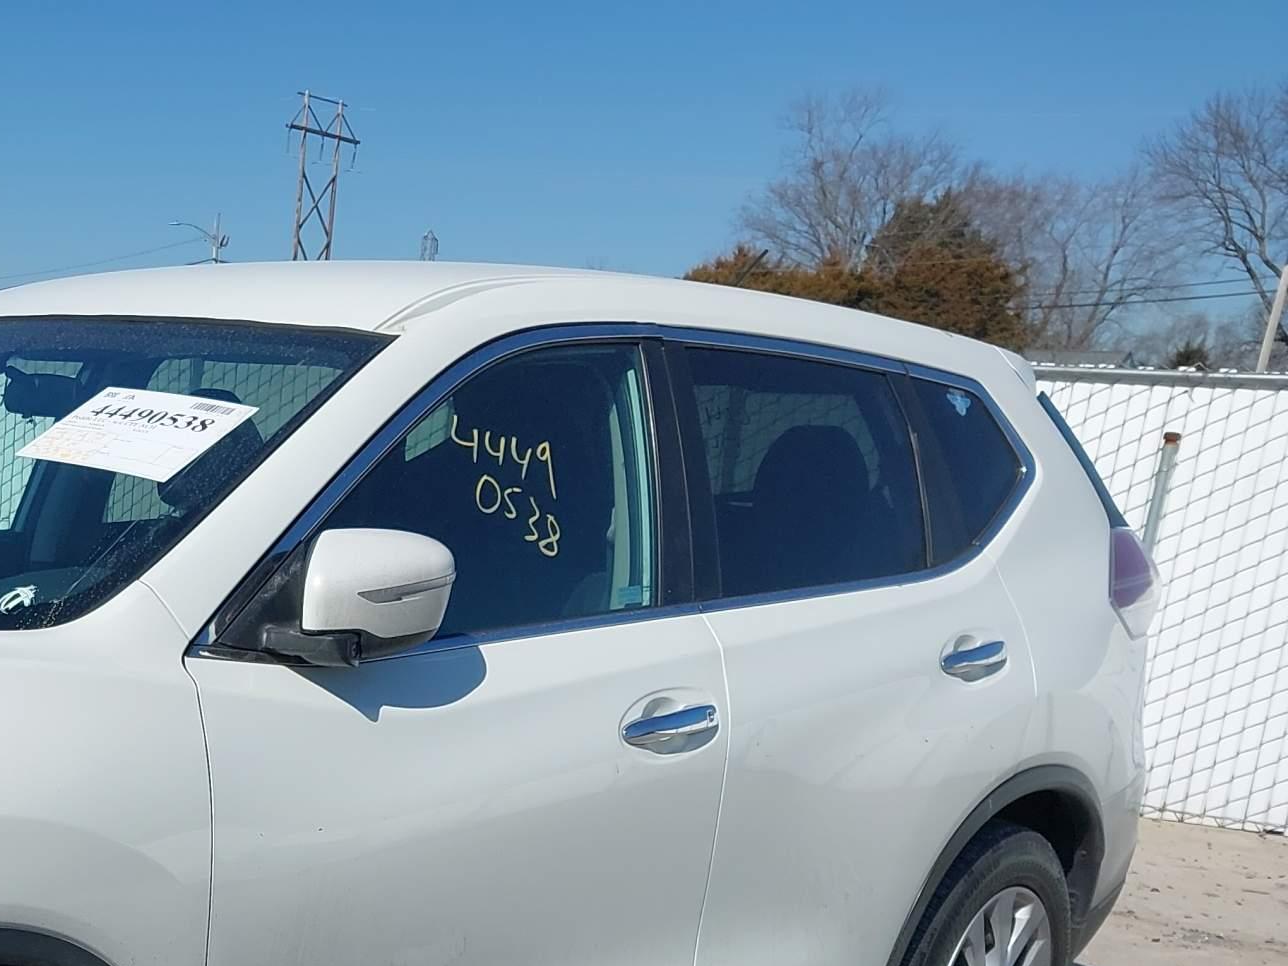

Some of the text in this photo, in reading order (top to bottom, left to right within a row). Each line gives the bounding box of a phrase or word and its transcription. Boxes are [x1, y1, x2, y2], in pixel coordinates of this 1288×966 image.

[91, 404, 215, 433] 44490538
[450, 414, 556, 500] 4449
[476, 474, 560, 557] 0538
